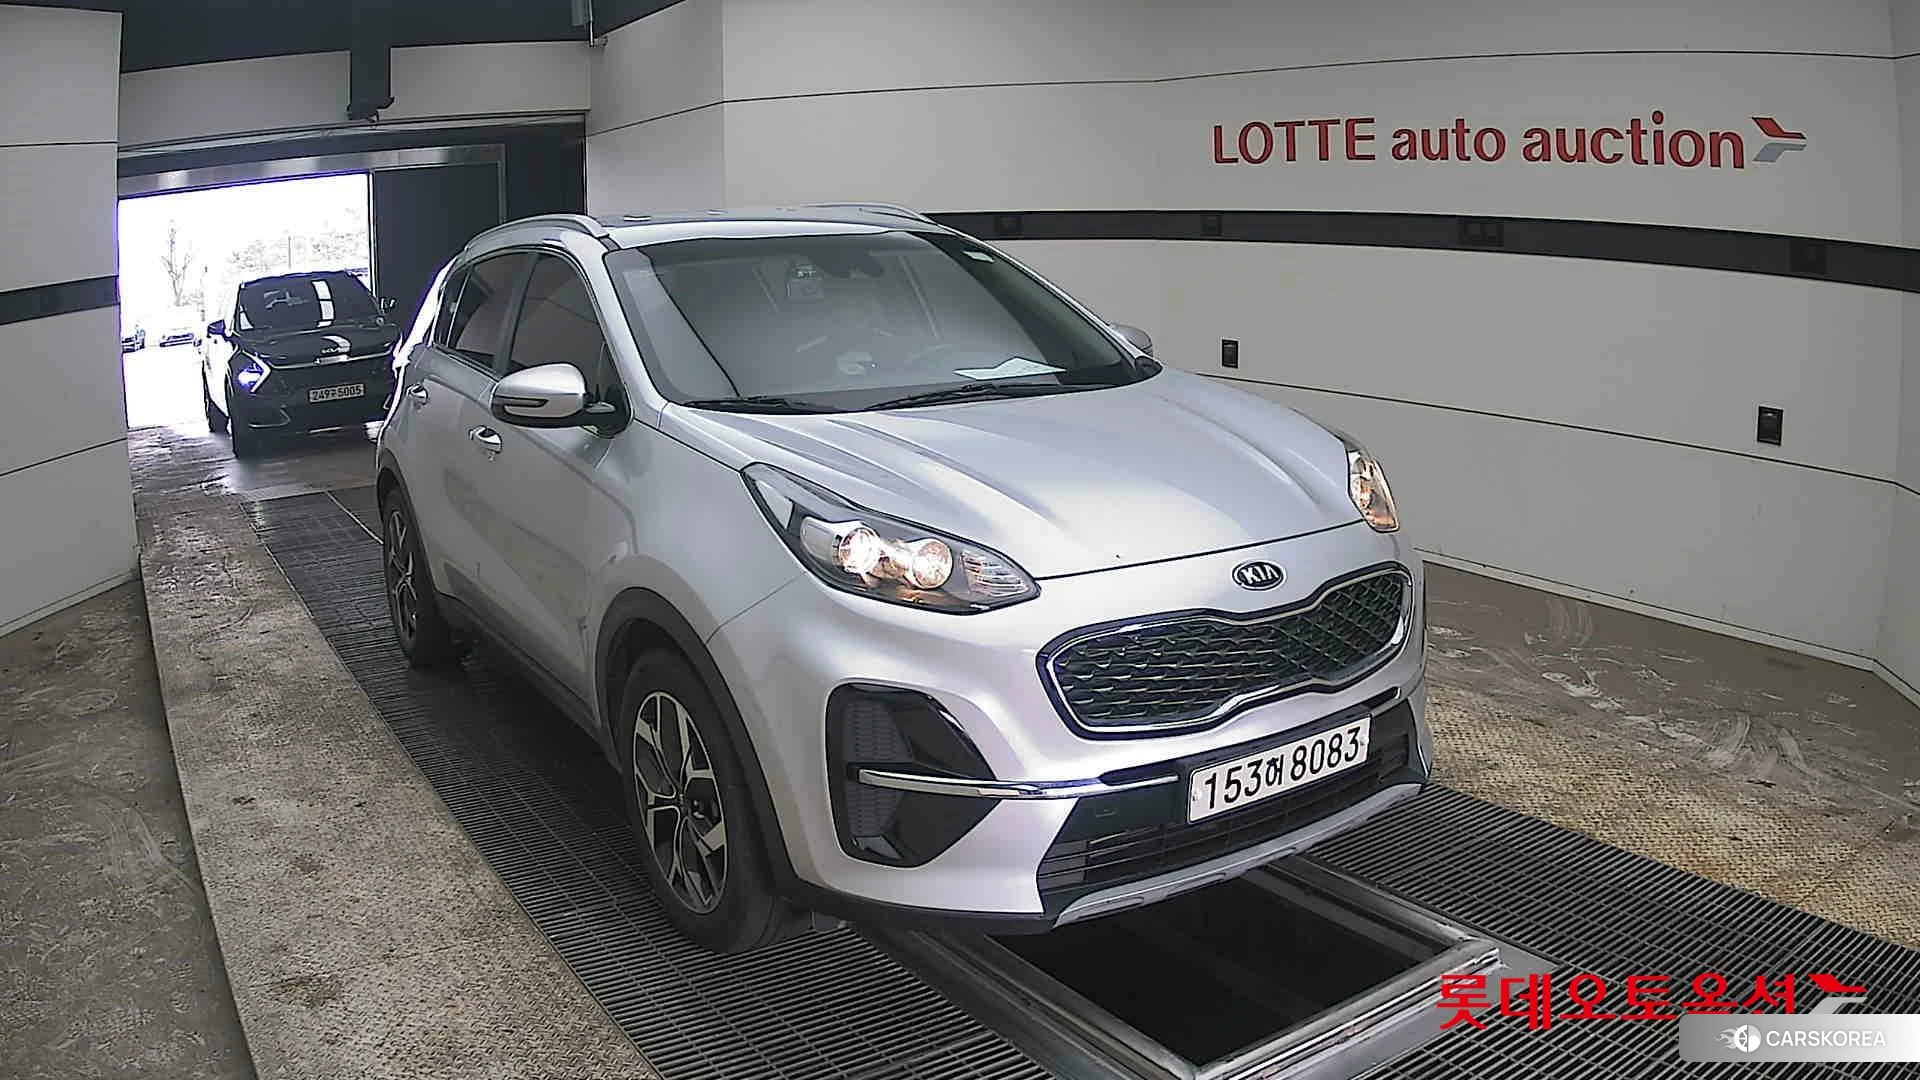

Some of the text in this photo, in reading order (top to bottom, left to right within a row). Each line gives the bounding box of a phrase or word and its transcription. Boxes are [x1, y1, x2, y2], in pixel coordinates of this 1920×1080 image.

[1213, 110, 1745, 169] LOTTE auto auction
[1240, 564, 1280, 585] KIA
